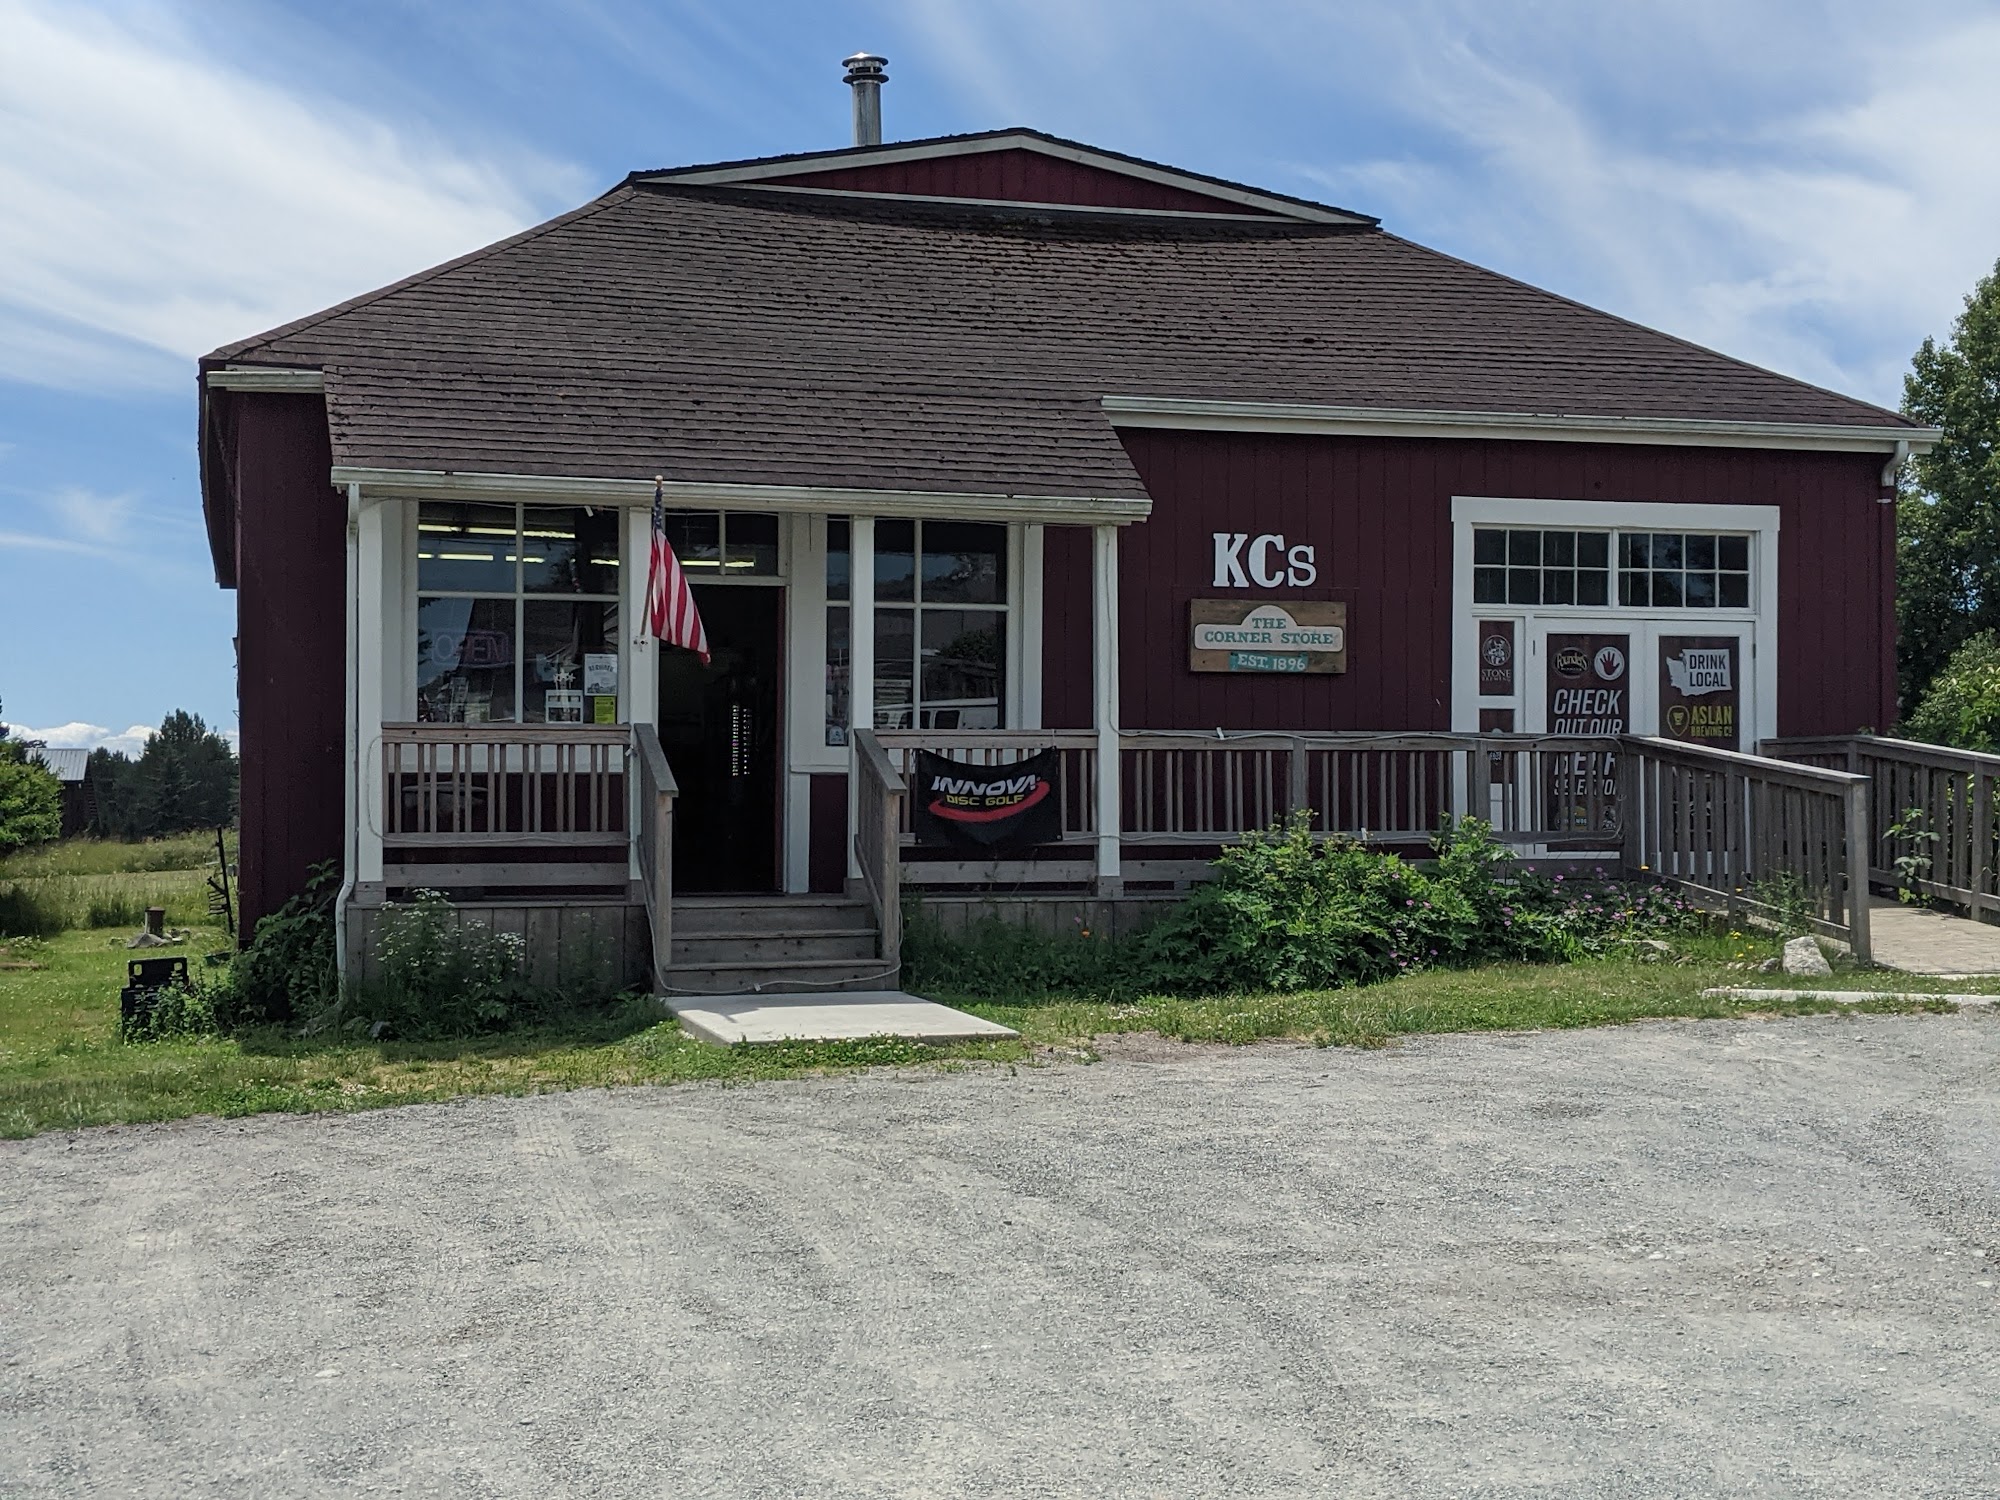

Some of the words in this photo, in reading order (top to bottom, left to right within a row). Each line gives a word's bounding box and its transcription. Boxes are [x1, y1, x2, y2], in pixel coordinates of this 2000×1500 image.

[1212, 532, 1317, 588] KCs
[1251, 617, 1287, 629] THE
[1204, 631, 1272, 644] CORNER
[1280, 632, 1334, 645] STORE
[1237, 653, 1269, 669] EST.
[1273, 657, 1306, 671] 1896
[1689, 654, 1727, 670] DRINK
[1481, 668, 1512, 678] STONE
[1689, 671, 1727, 687] LOCAL
[1553, 688, 1623, 715] CHECK
[1691, 705, 1733, 725] ASLAN
[1691, 725, 1722, 737] BREWING
[930, 774, 1036, 796] INNOVA
[946, 794, 980, 806] DISC
[985, 794, 1025, 806] GOLF
